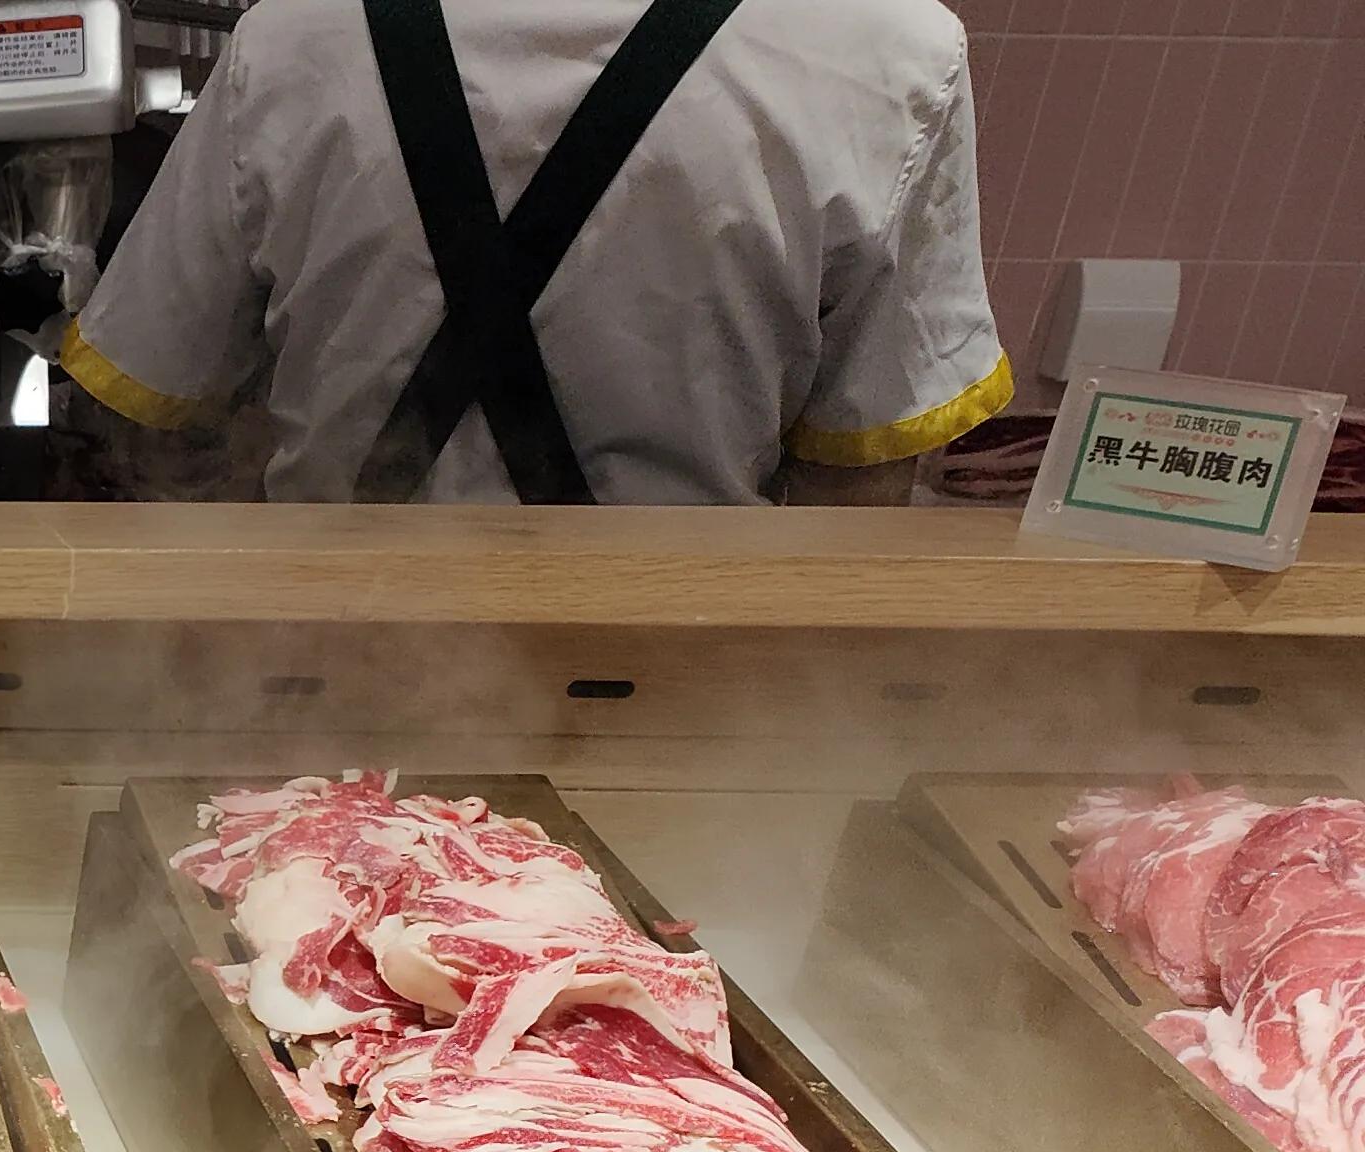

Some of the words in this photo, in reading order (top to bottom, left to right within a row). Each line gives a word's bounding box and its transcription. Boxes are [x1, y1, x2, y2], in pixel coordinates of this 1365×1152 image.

[1087, 435, 1274, 488] 黑牛胸腹肉
